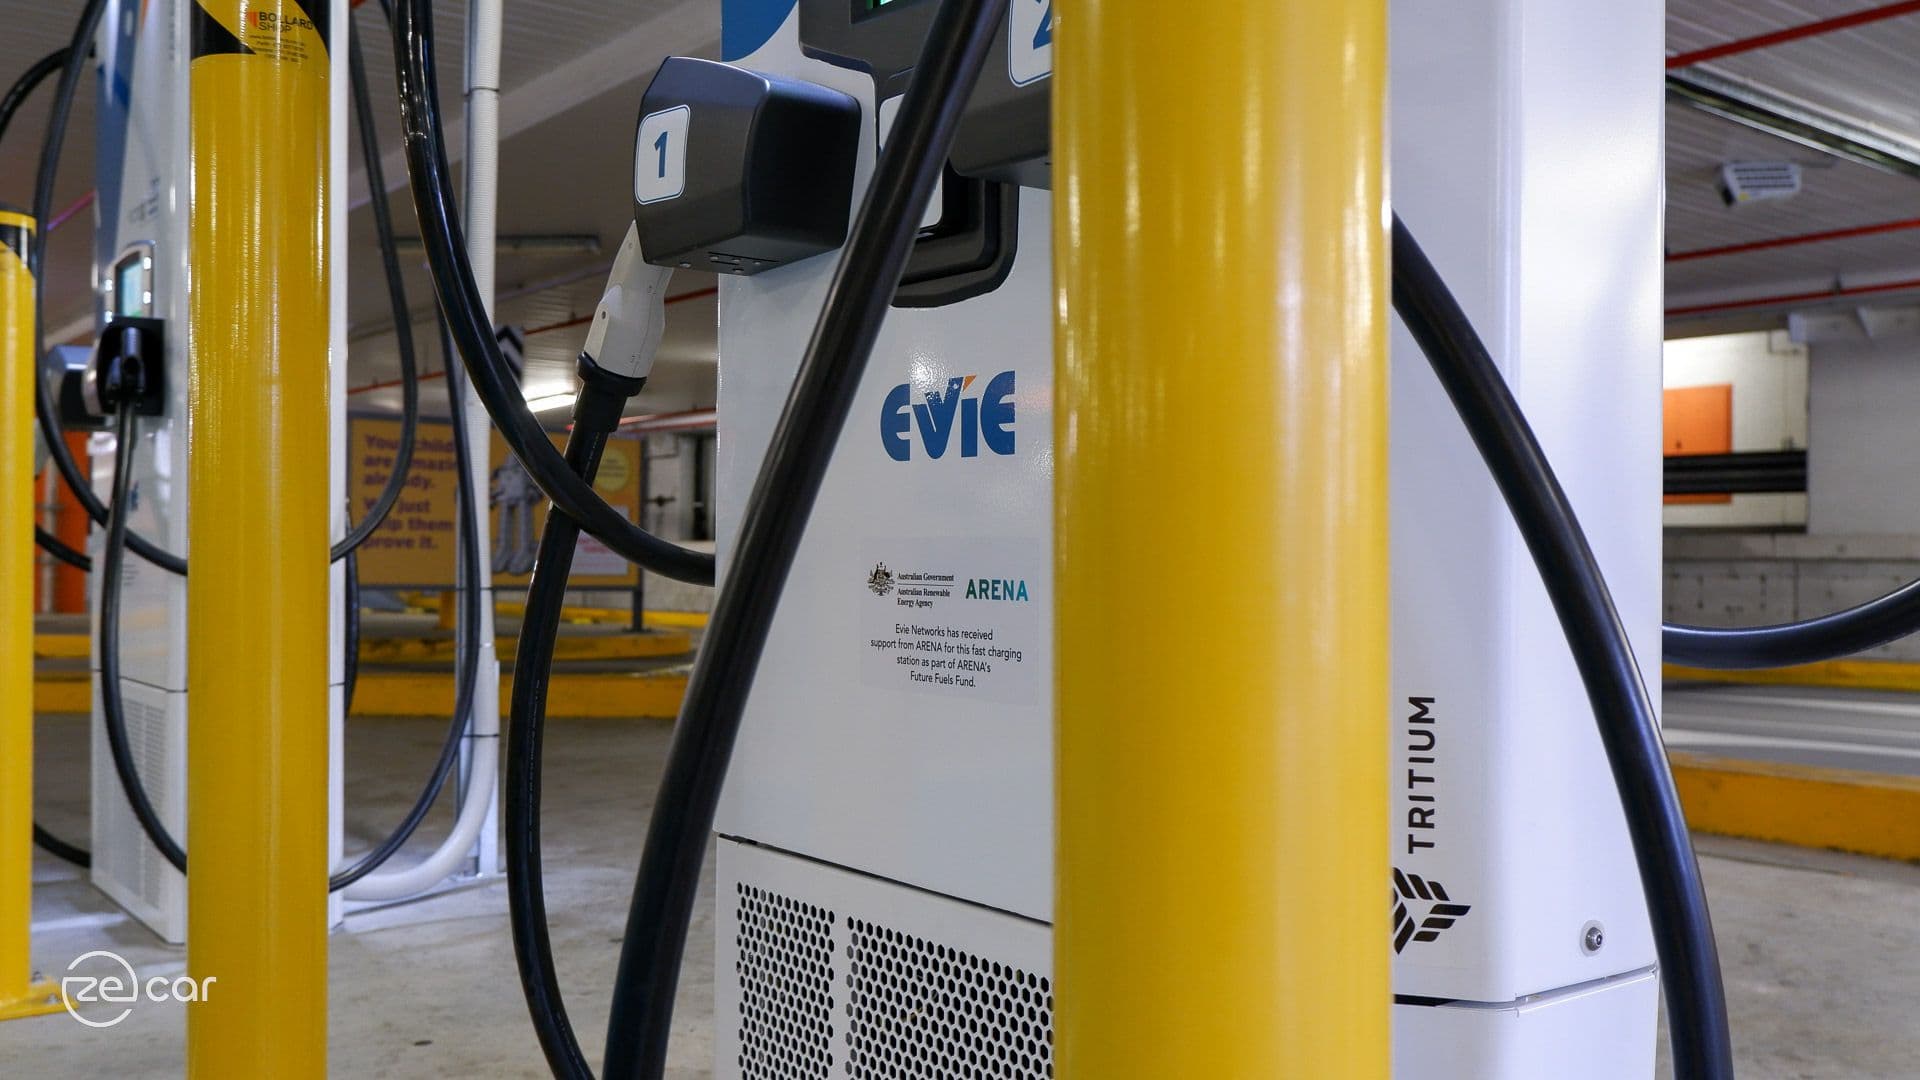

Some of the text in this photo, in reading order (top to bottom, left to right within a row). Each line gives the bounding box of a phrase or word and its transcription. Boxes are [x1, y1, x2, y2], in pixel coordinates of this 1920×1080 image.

[259, 22, 291, 32] SHOP
[654, 131, 668, 179] 1
[897, 573, 954, 582] Australian Government
[897, 588, 950, 597] Australian Renewable
[965, 579, 1028, 601] ARENA
[897, 598, 933, 608] Energy Agency
[896, 624, 993, 640] Evie Networks has received
[870, 639, 1022, 662] support from ARENA for this fast charging
[897, 656, 919, 666] station
[922, 659, 929, 667] as
[931, 659, 946, 670] part
[948, 659, 956, 669] of
[910, 671, 976, 688] Future Fuels Fund.
[1408, 697, 1435, 854] TRITIUM
